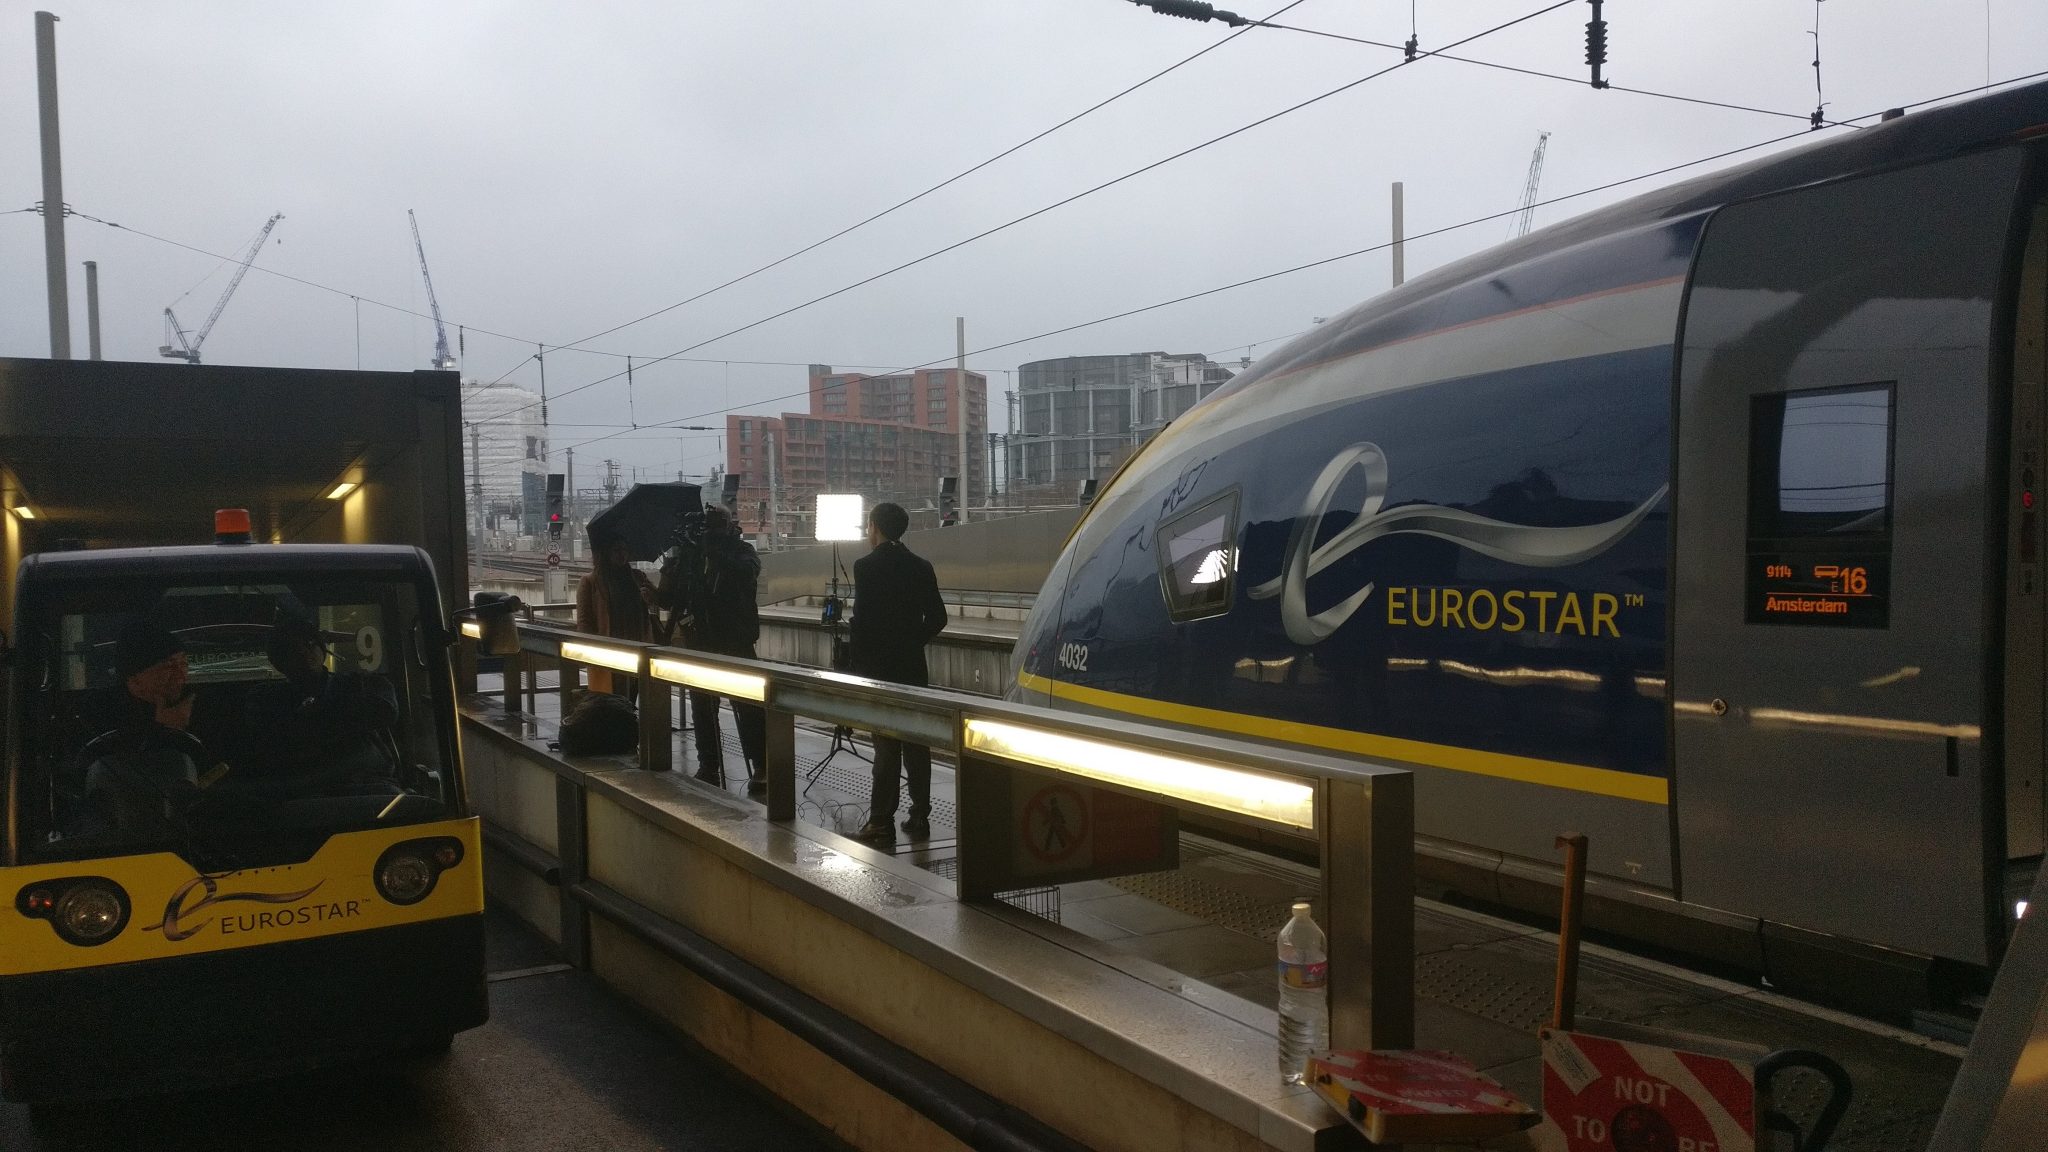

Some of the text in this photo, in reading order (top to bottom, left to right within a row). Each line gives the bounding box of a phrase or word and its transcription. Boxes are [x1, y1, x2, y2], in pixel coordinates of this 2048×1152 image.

[1766, 565, 1792, 578] 9114
[1840, 567, 1867, 594] 16
[1766, 597, 1847, 613] Amsterdam
[356, 626, 382, 672] 9
[1058, 642, 1087, 671] 4032
[1614, 1076, 1671, 1108] NOT
[1572, 1115, 1605, 1143] TO
